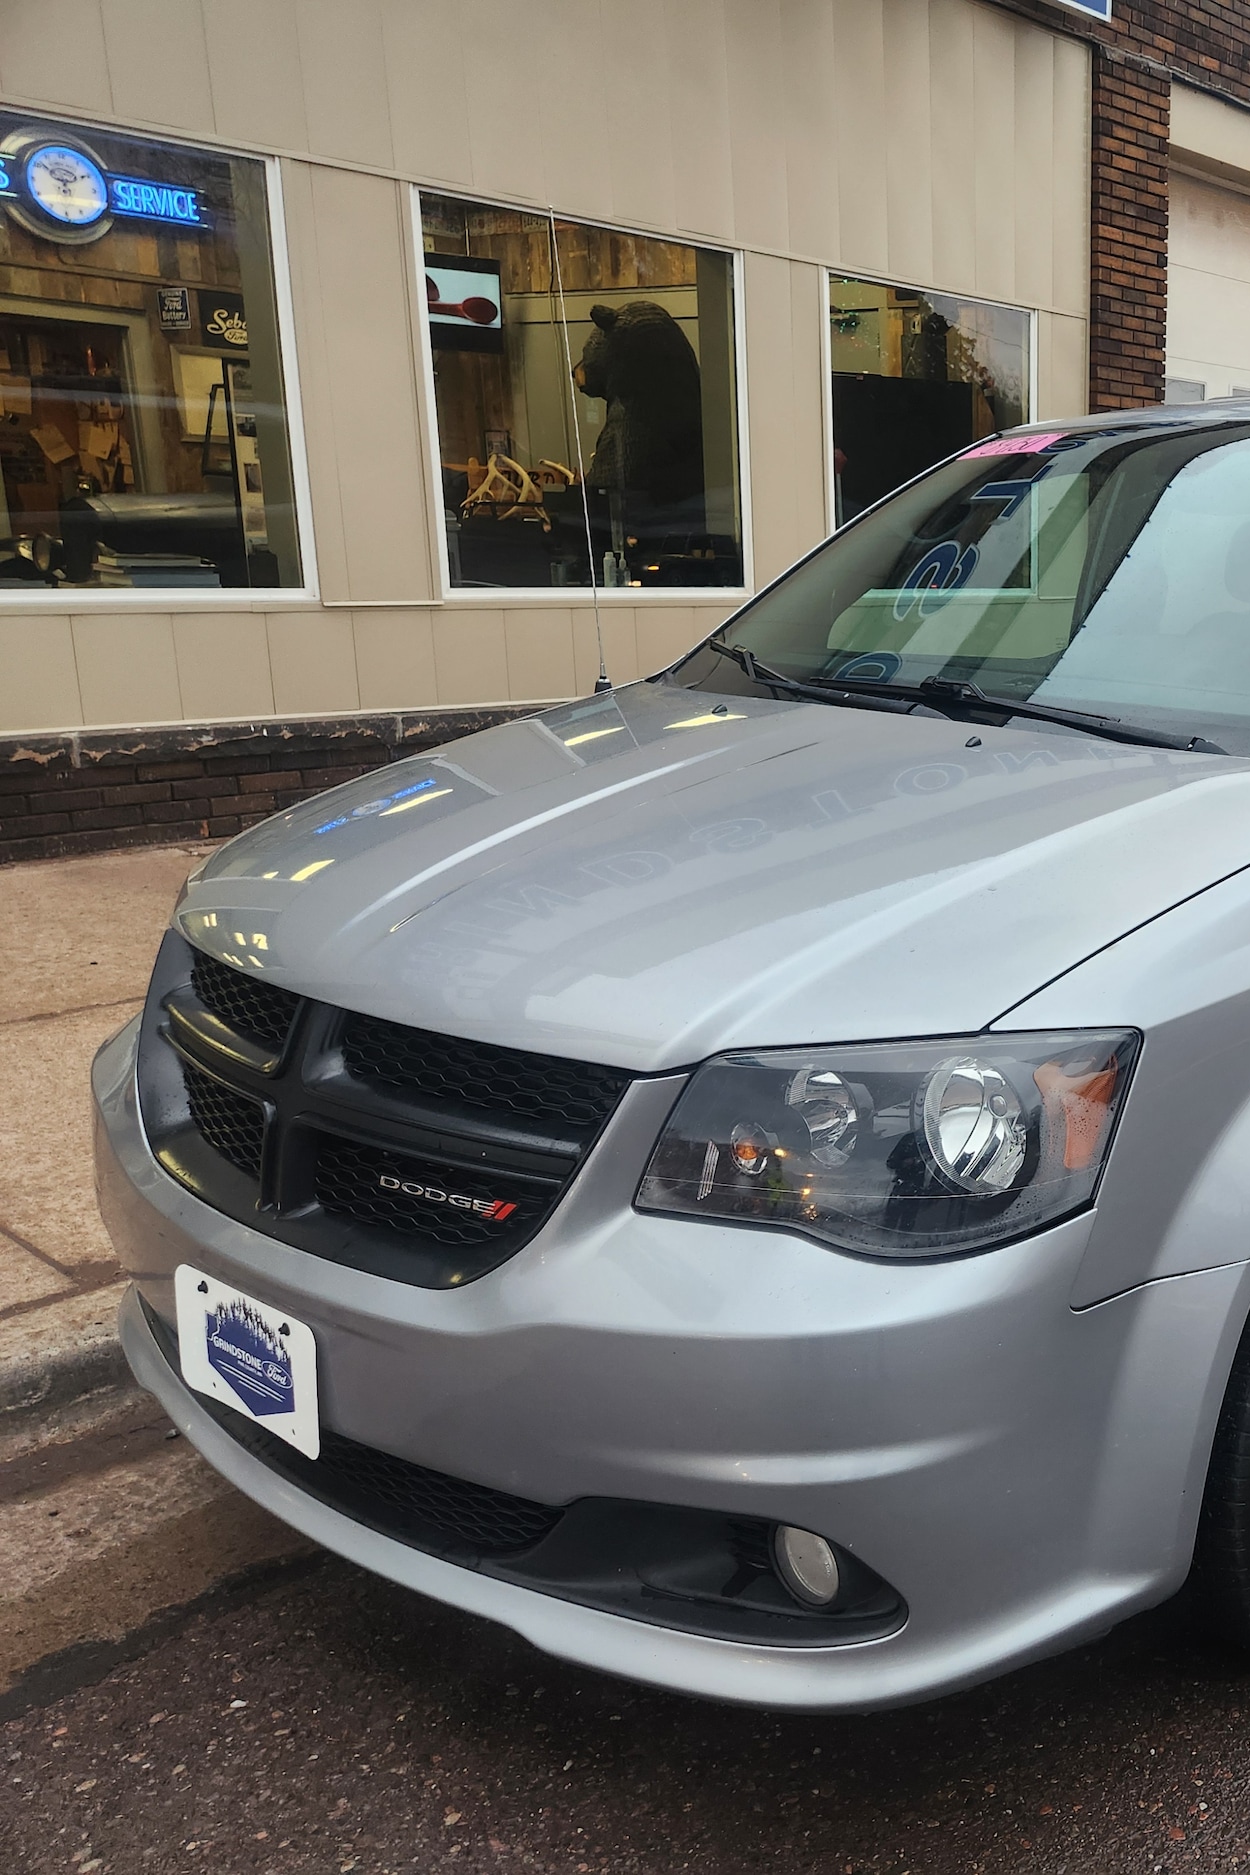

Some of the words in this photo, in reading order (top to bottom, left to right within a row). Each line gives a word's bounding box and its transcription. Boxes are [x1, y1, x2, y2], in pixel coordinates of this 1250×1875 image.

[112, 180, 200, 221] SERVICE
[379, 1175, 496, 1215] DODGE
[213, 1335, 262, 1370] GRINDSTONE
[266, 1364, 287, 1386] Ford
